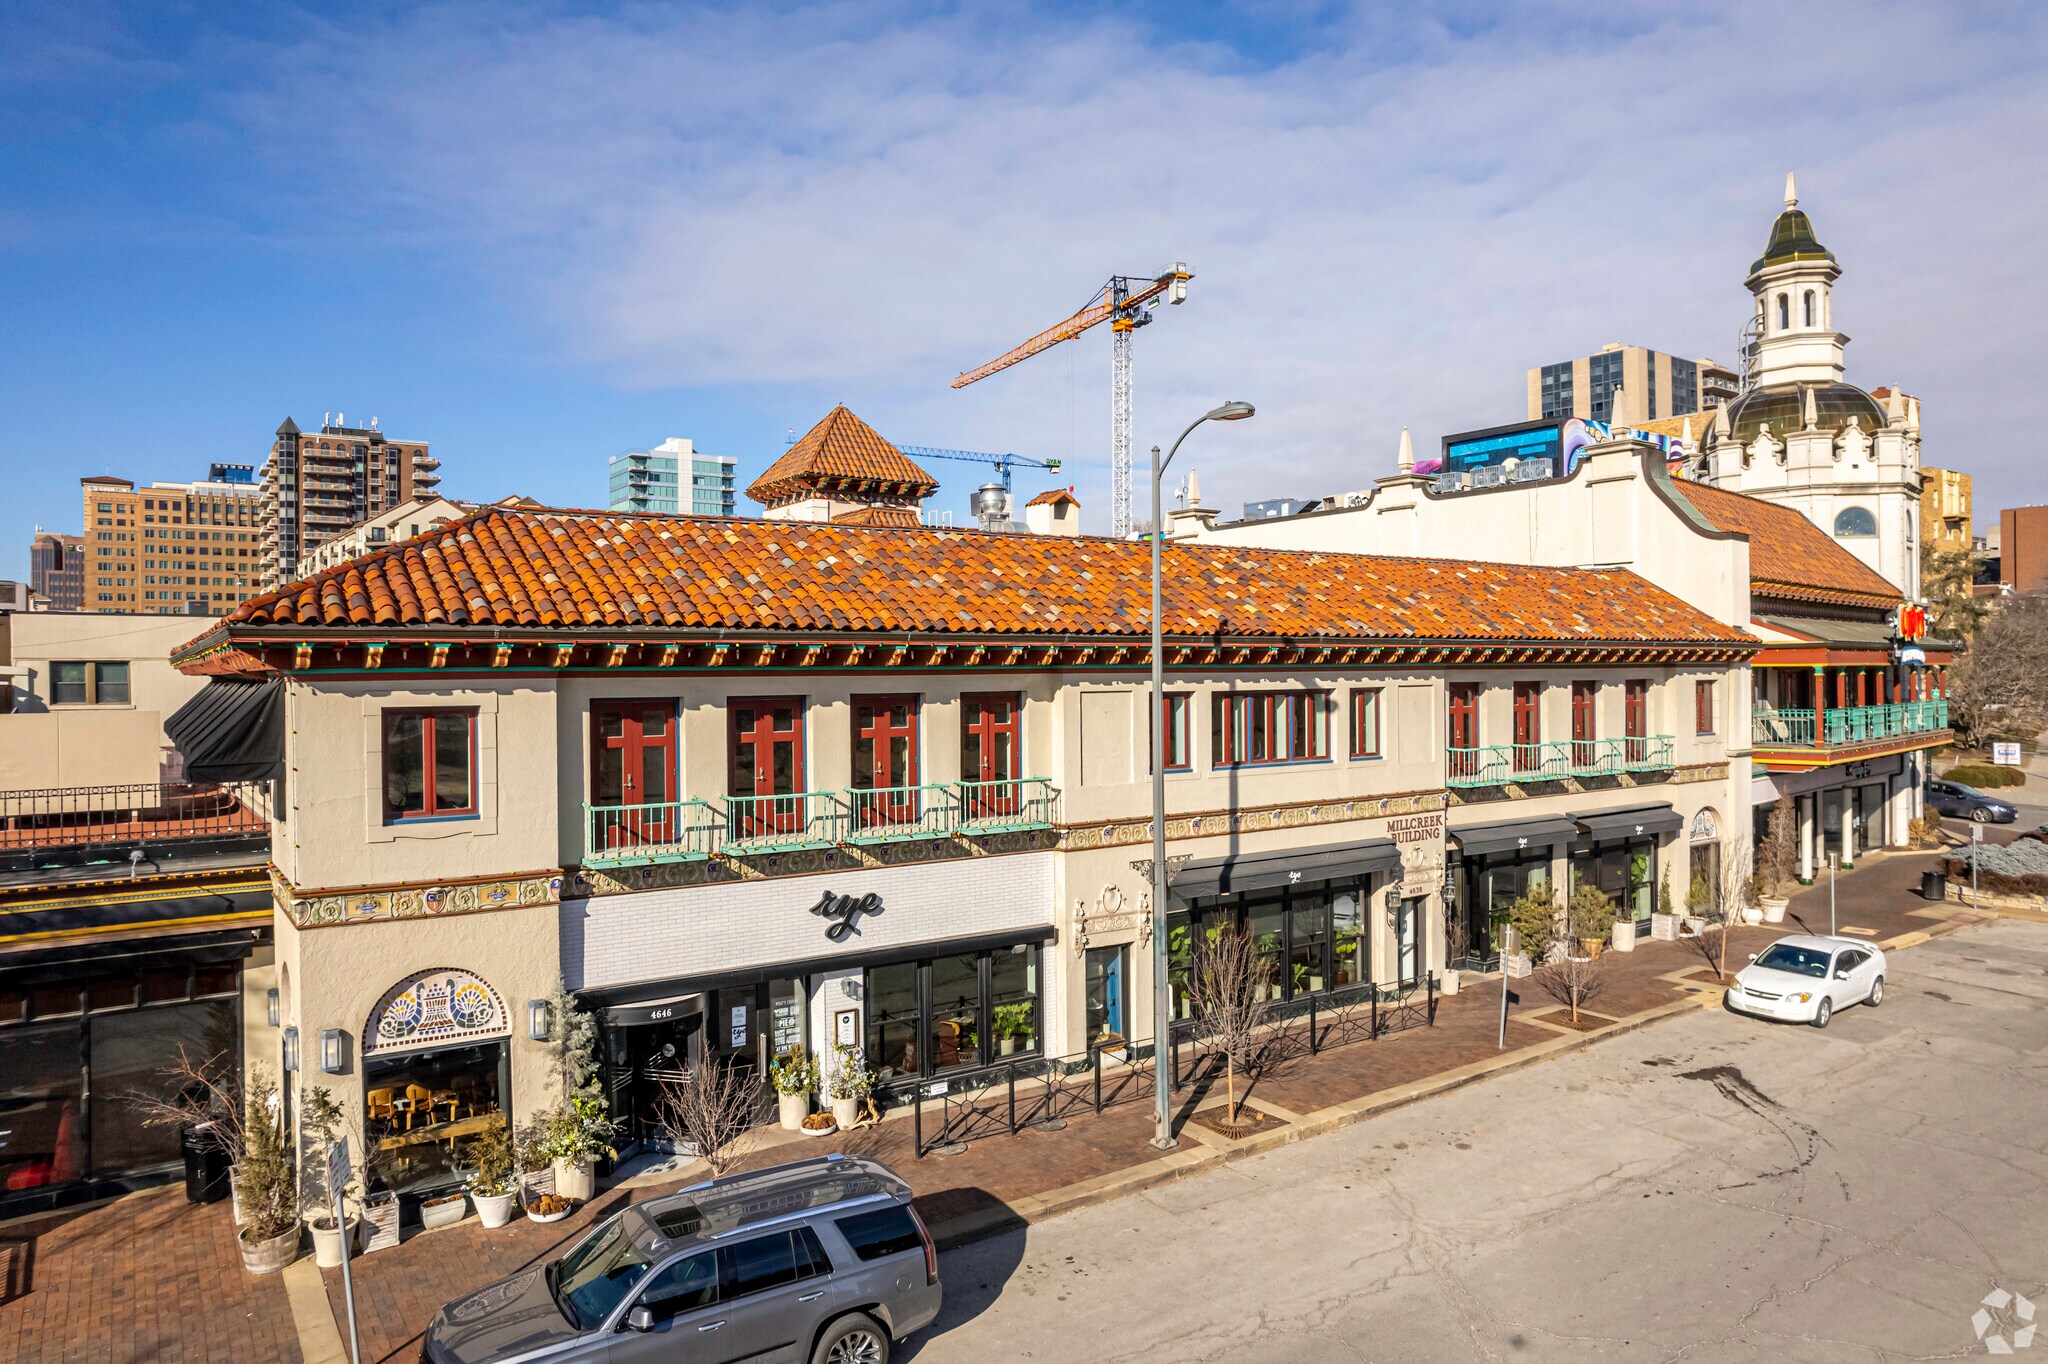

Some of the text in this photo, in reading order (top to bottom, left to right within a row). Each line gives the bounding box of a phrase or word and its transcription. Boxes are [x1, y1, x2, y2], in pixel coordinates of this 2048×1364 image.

[1387, 815, 1443, 832] MILLCREEK
[1391, 828, 1440, 844] BUILDING
[809, 890, 878, 939] rye
[651, 1008, 672, 1019] 4646
